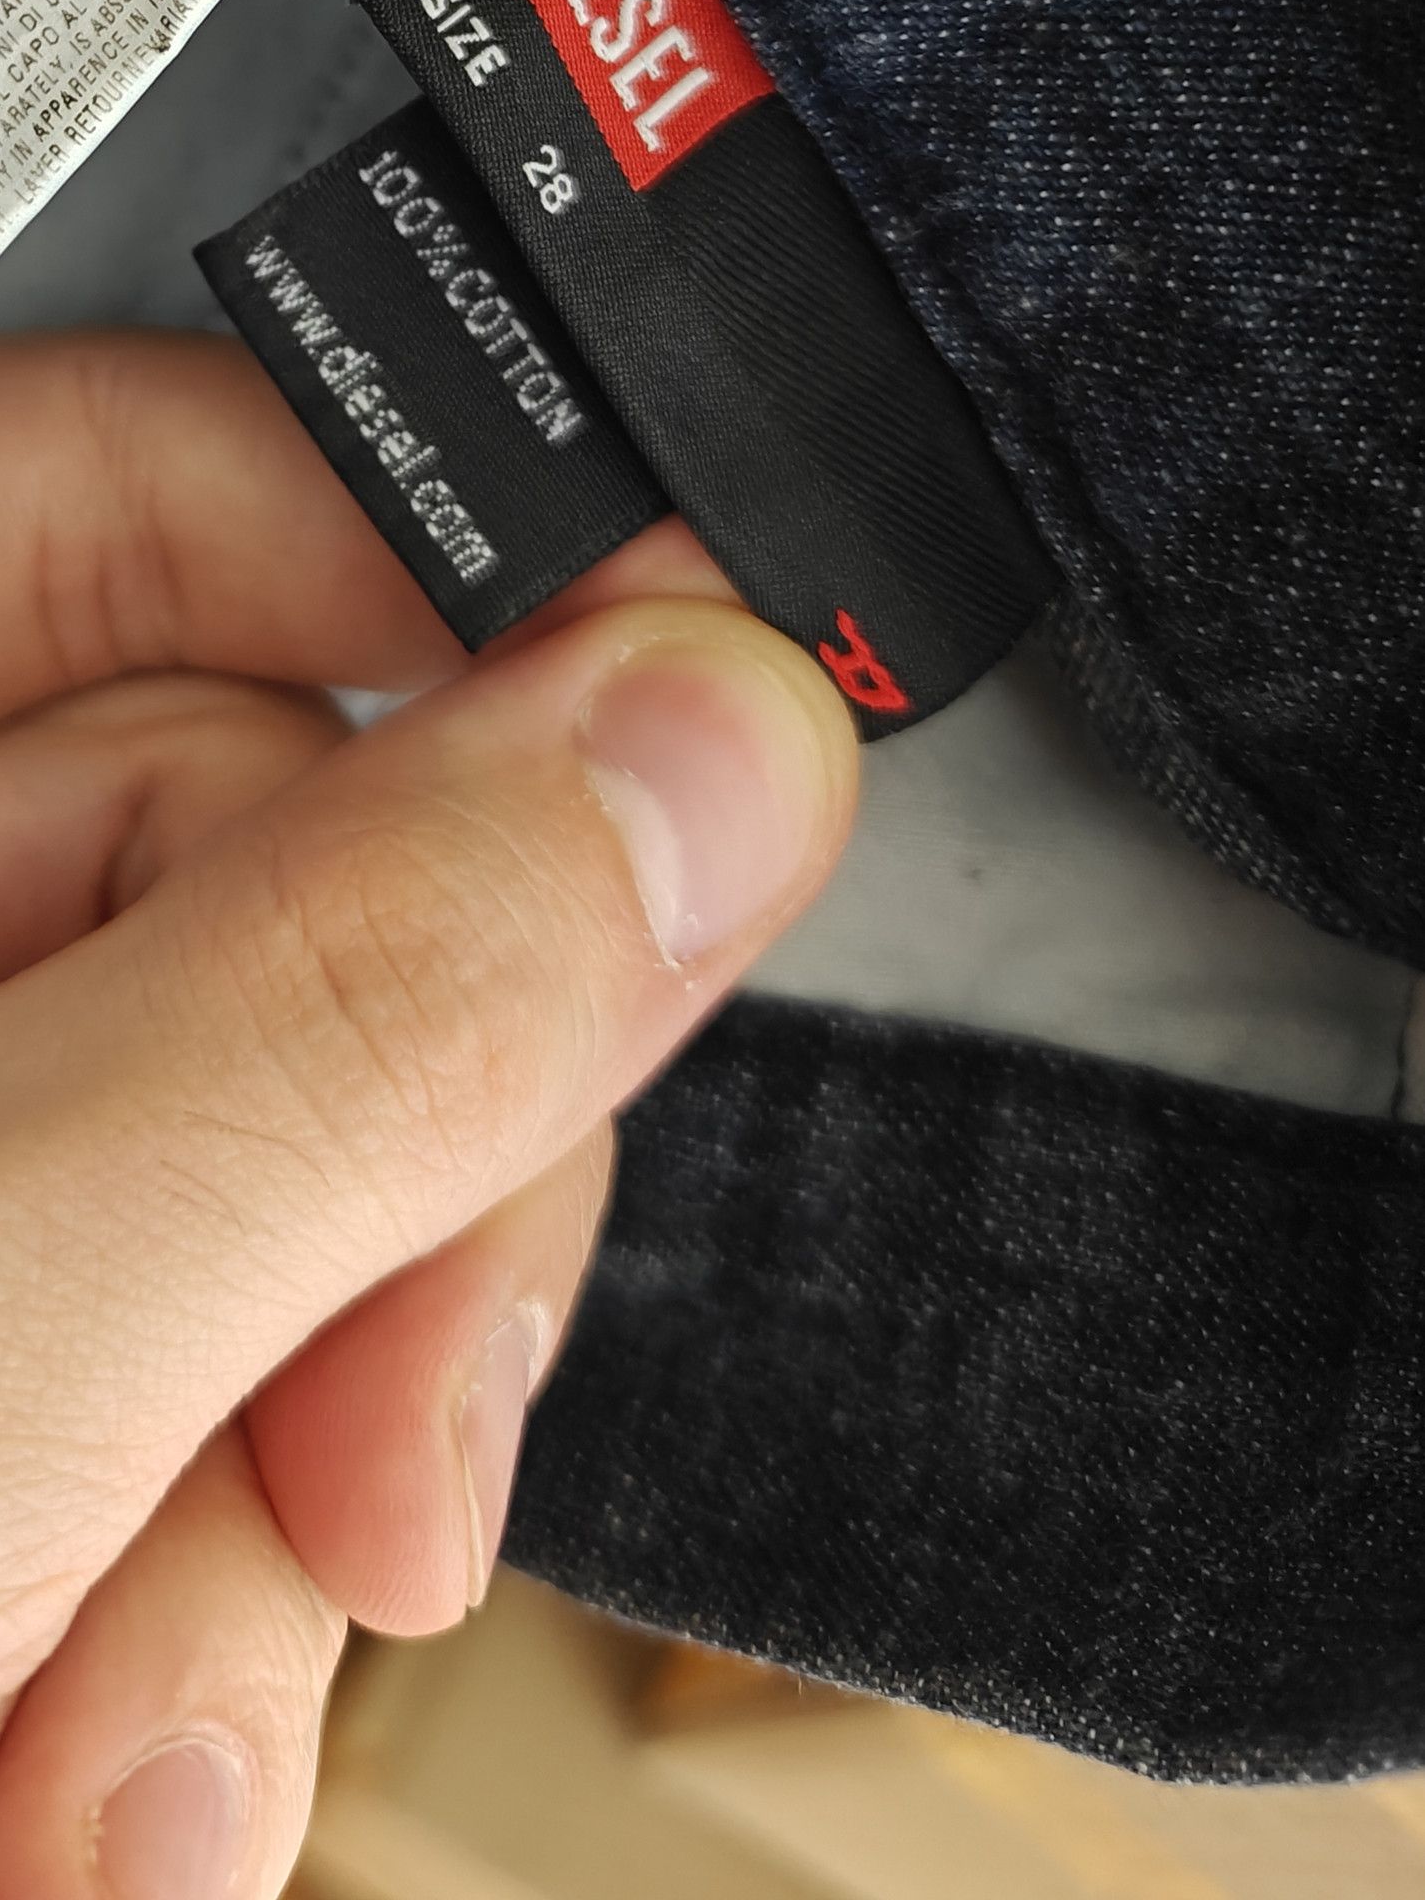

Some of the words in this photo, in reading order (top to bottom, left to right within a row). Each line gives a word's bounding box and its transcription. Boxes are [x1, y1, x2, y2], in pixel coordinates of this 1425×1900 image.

[6, 25, 61, 84] CAPO
[57, 0, 87, 29] AL
[17, 5, 44, 32] DI
[68, 31, 93, 56] IS
[8, 139, 35, 166] IN
[30, 30, 130, 142] APPARENCE
[124, 7, 149, 34] IN
[14, 143, 67, 204] LAVER
[523, 145, 574, 214] 28
[245, 231, 501, 586] www.diesel.com
